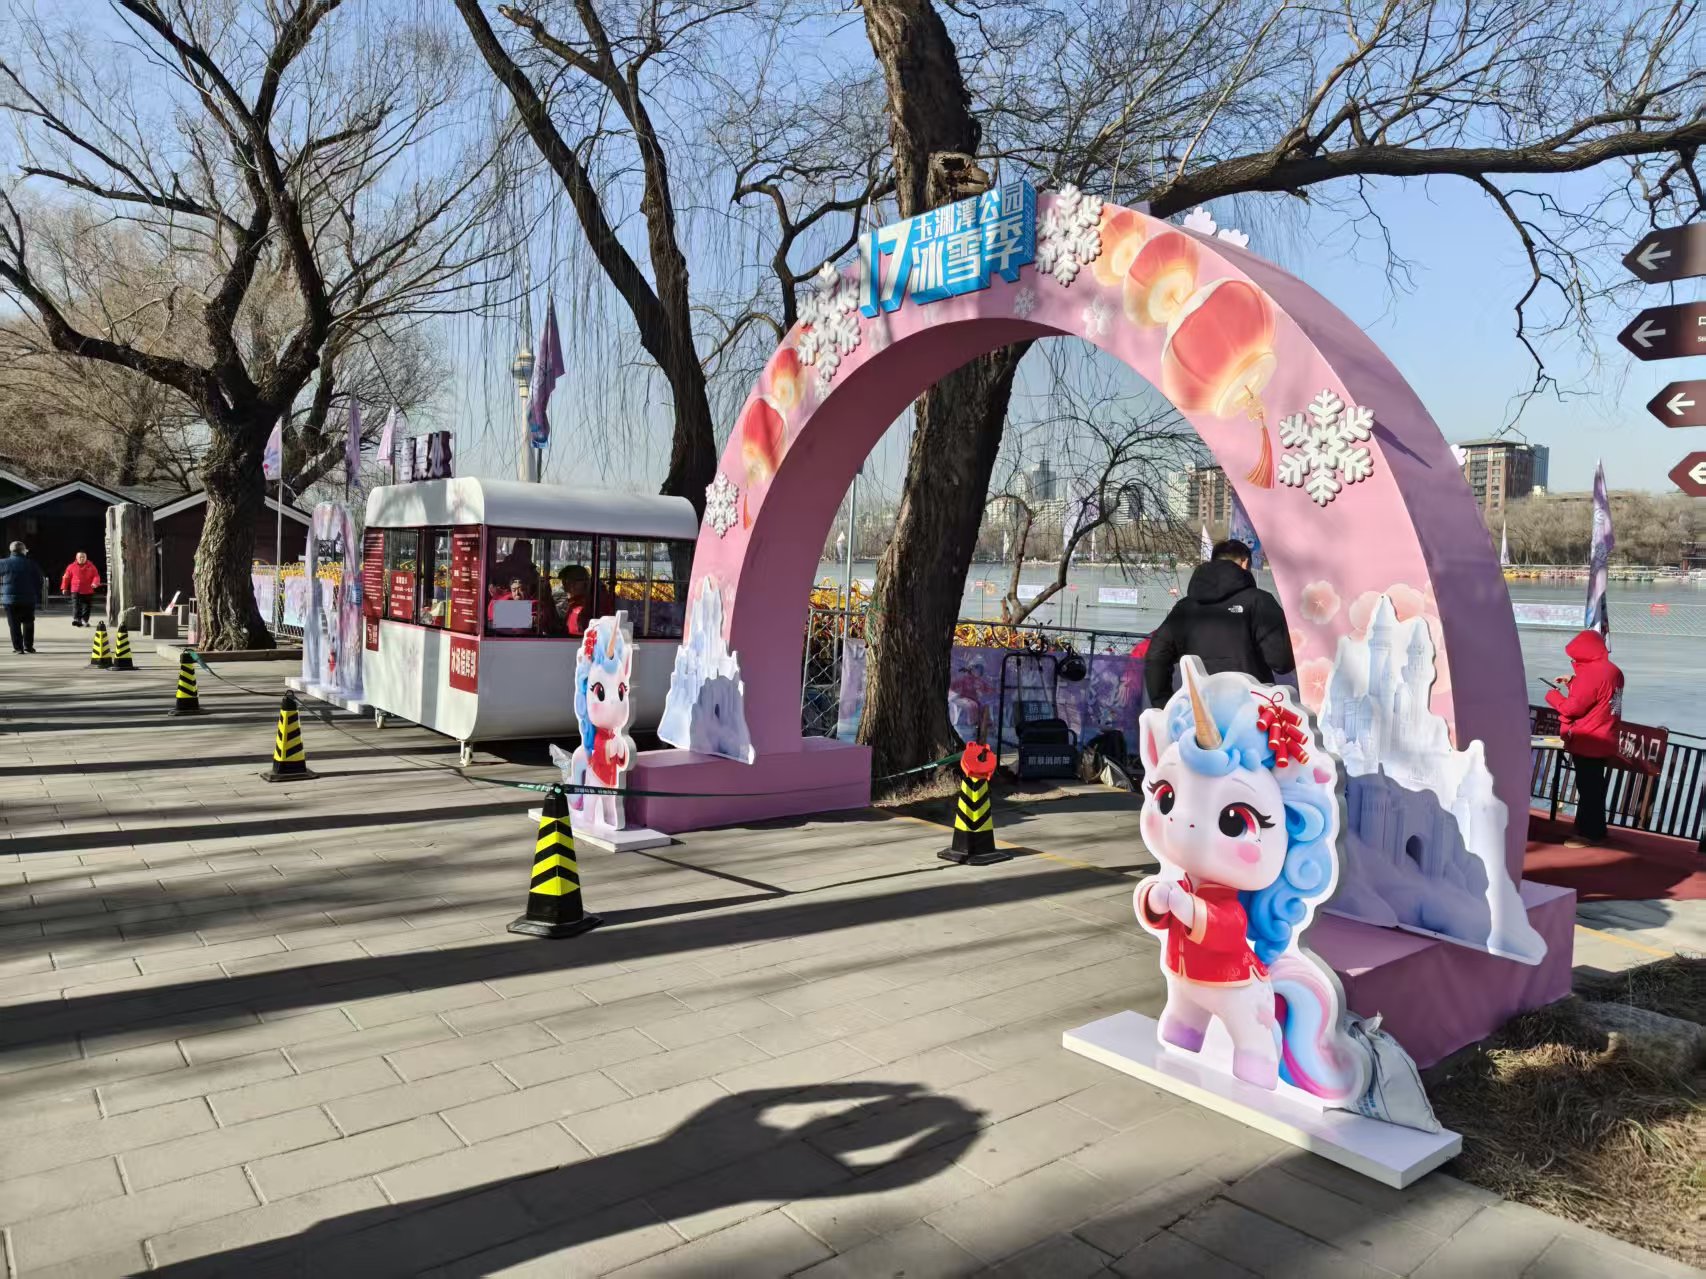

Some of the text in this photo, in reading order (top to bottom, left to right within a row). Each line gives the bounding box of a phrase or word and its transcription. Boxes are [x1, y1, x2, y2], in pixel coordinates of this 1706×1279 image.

[913, 181, 1023, 245] 玉渊潭公园
[859, 219, 913, 310] 17
[911, 215, 1023, 293] 冰雪季
